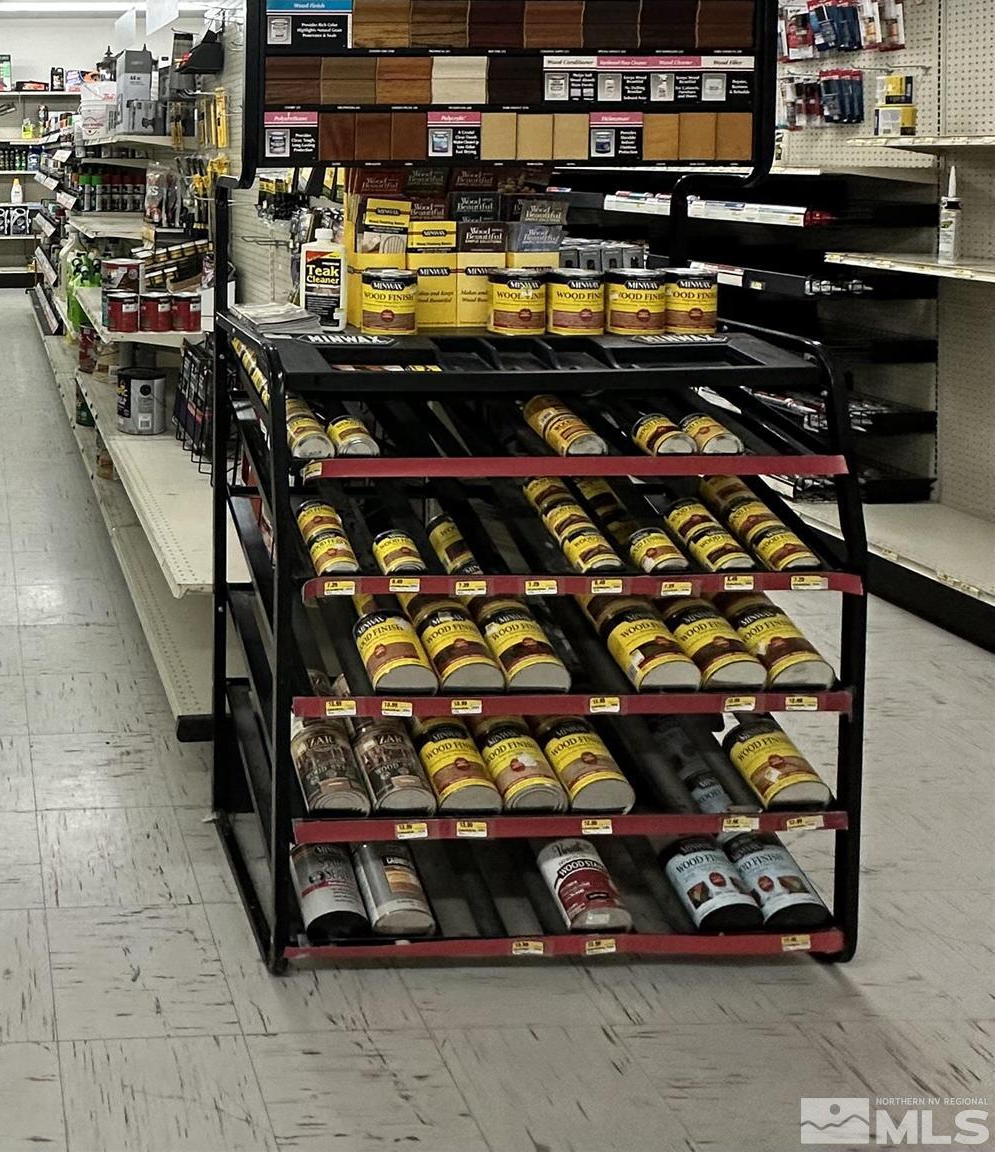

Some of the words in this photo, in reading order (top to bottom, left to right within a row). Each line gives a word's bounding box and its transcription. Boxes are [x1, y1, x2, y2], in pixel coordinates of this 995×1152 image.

[461, 197, 482, 206] Wood
[457, 203, 494, 212] Beautiful
[466, 232, 503, 241] Beautiful
[470, 227, 491, 235] Wood
[306, 264, 340, 277] Teak
[419, 268, 449, 276] MINWAX
[467, 268, 488, 276] MINW
[306, 275, 340, 285] Cleaner
[569, 280, 600, 289] MINWAX
[626, 281, 659, 290] MINWAX
[679, 280, 711, 289] MINWAX
[373, 282, 404, 291] MINWAX
[364, 291, 386, 301] WOOD
[387, 292, 414, 302] FINISH
[556, 291, 586, 301] WOOD
[671, 291, 696, 300] OOD
[372, 623, 405, 639] FINISH
[426, 625, 452, 644] WOOD
[492, 623, 521, 641] WOOD
[620, 622, 650, 638] WOOD
[680, 623, 708, 642] WOOD
[743, 624, 764, 642] OOD
[306, 735, 334, 748] ZAR
[550, 738, 578, 756] WOOD
[426, 742, 452, 760] WOOD
[738, 741, 762, 762] WOOD
[559, 860, 584, 876] WOOD
[676, 854, 704, 874] WOOD
